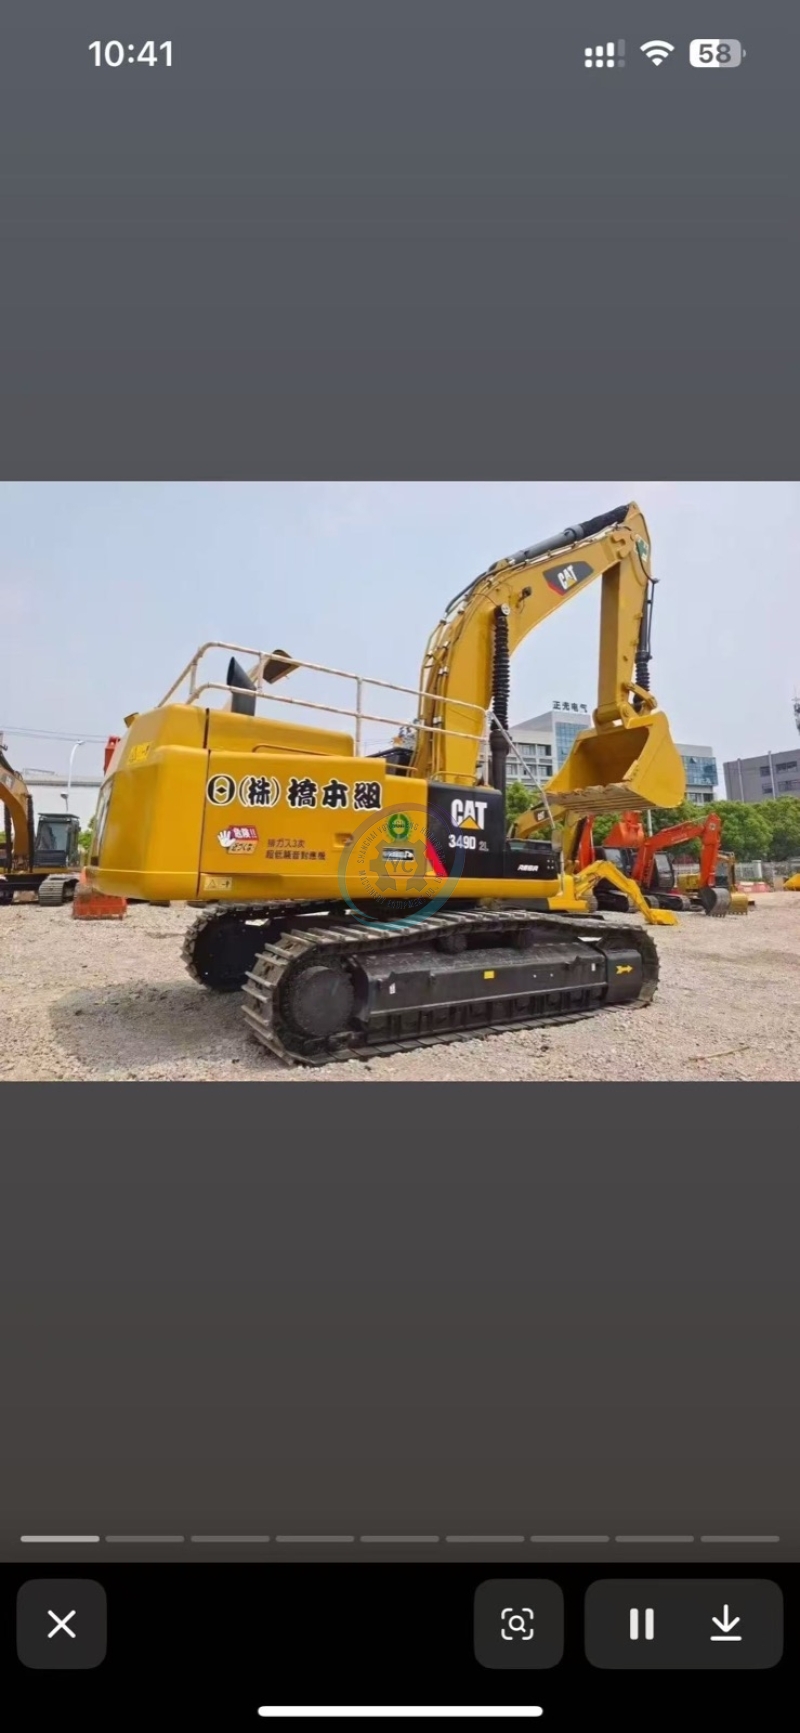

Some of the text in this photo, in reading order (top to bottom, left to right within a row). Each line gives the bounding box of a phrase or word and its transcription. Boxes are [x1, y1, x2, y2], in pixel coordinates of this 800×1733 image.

[88, 41, 174, 66] 10:41
[698, 43, 731, 64] 58
[557, 564, 578, 590] CAT
[451, 799, 488, 830] CAT
[448, 834, 476, 849] 349D
